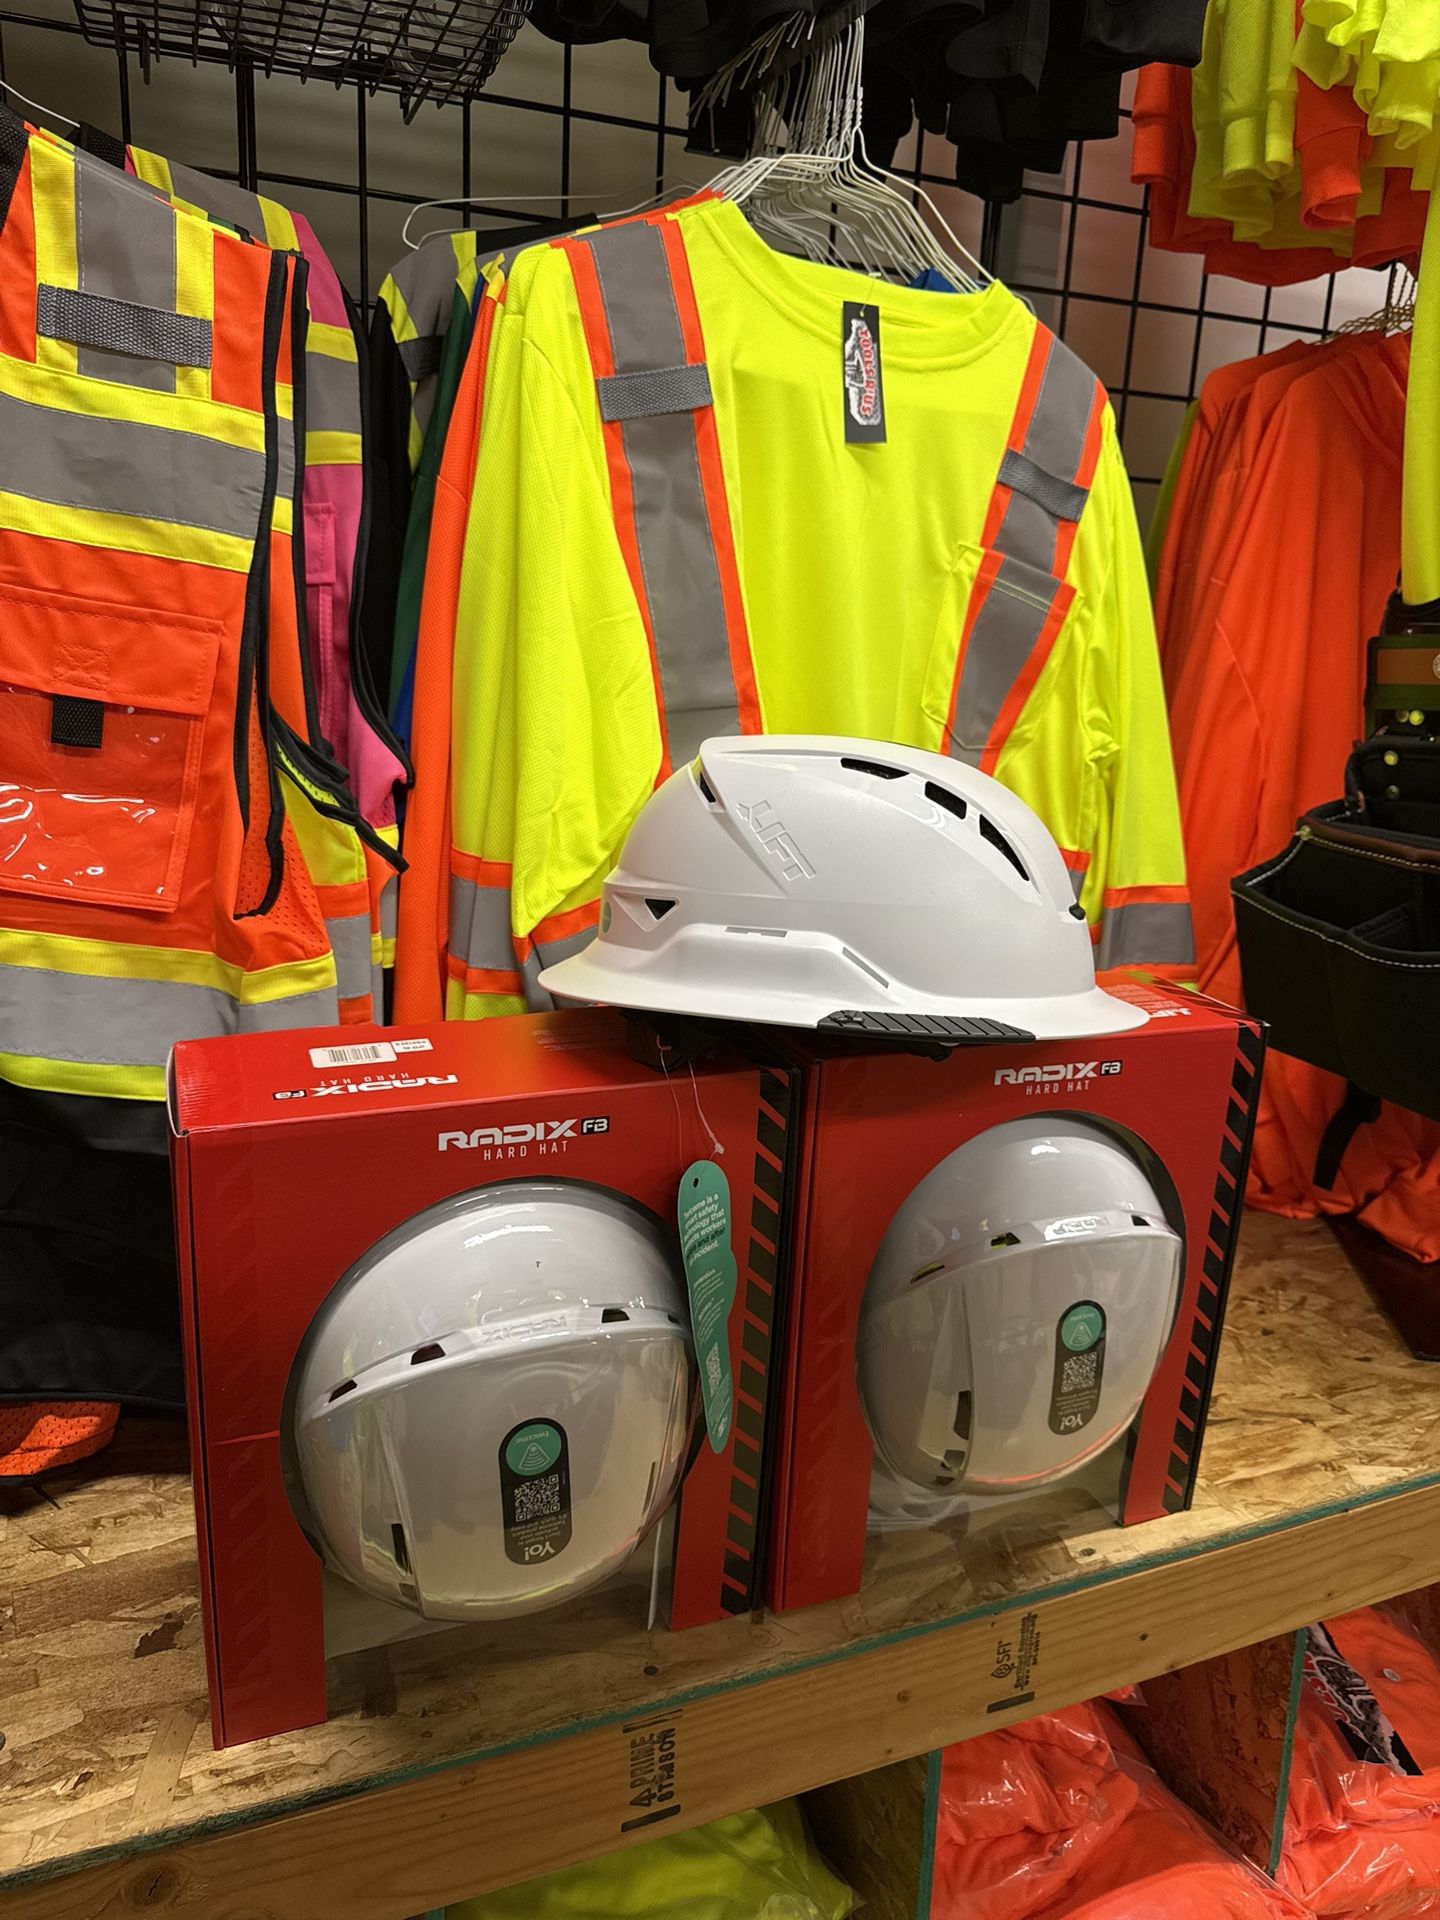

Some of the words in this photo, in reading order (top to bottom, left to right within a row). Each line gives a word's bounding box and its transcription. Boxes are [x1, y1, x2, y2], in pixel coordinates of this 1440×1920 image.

[858, 327, 876, 377] TOOLS
[994, 1062, 1099, 1085] RADIX
[310, 1074, 458, 1097] RADIX
[1026, 1083, 1060, 1096] HARD
[1067, 1080, 1090, 1092] HAT
[438, 1119, 578, 1152] RADIX
[484, 1145, 527, 1161] HARD
[539, 1141, 568, 1155] HAT
[698, 1203, 719, 1219] safety
[711, 1208, 725, 1221] that
[1060, 1413, 1083, 1431] Yo!
[524, 1541, 556, 1561] Yo!
